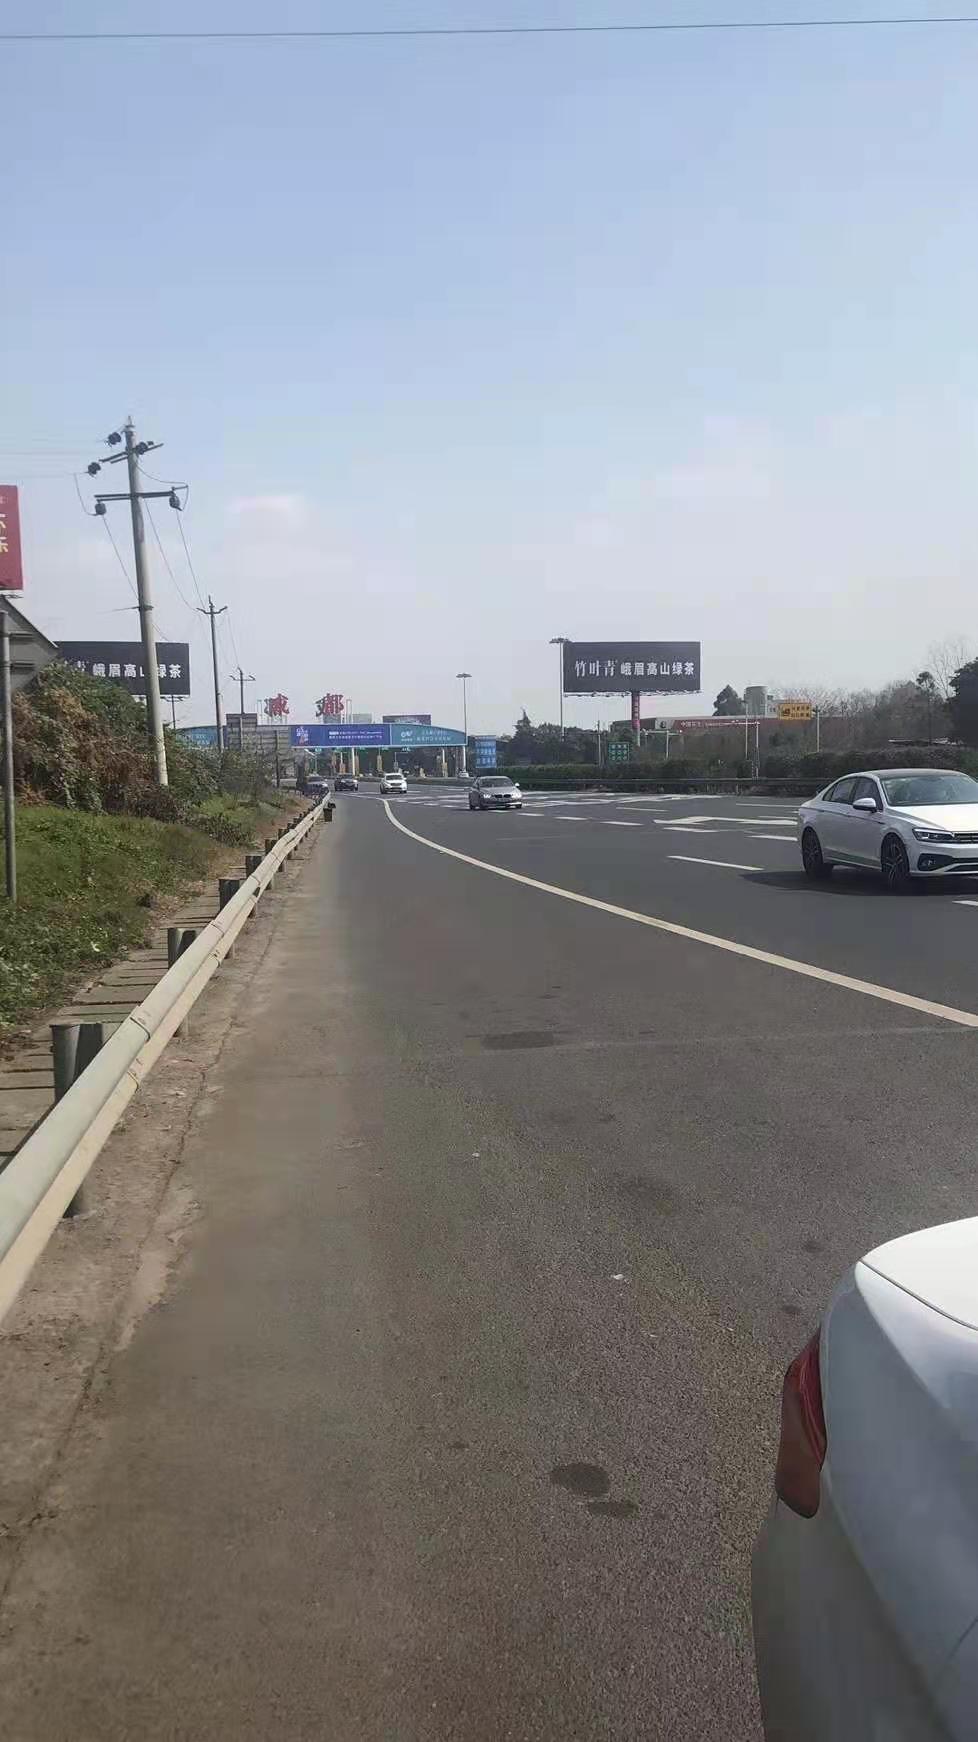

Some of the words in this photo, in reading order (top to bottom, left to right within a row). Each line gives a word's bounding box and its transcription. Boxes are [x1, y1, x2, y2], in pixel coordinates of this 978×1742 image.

[620, 661, 695, 677] 峨眉高山绿茶
